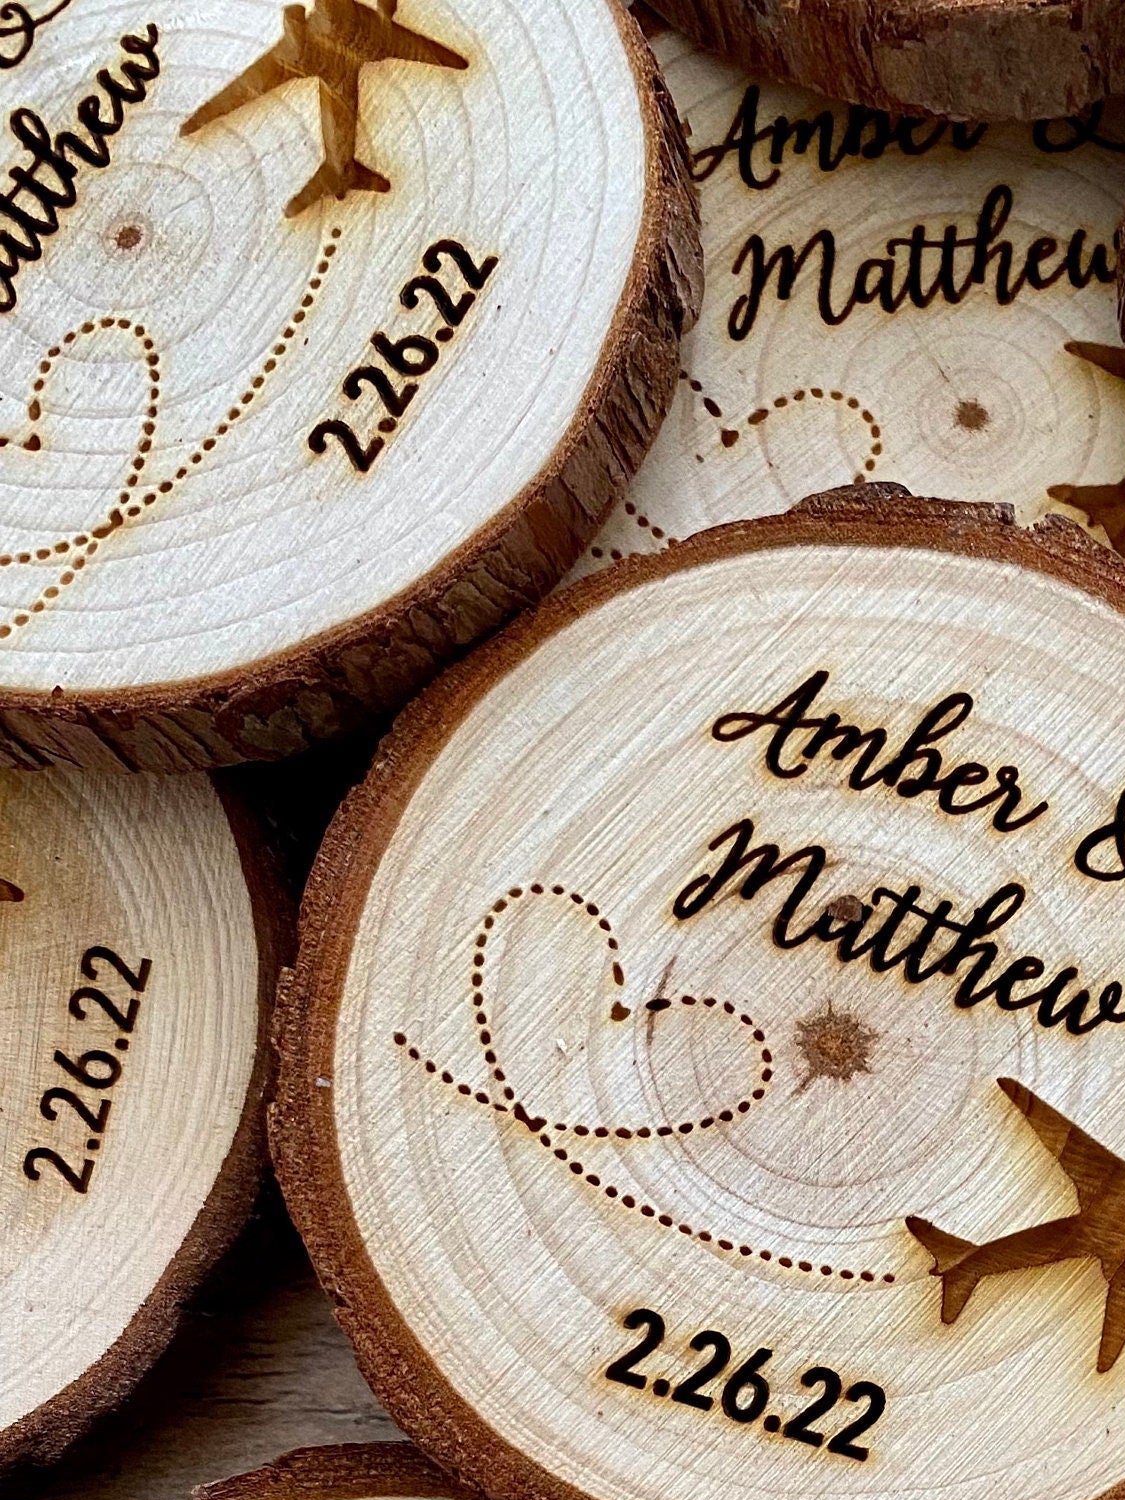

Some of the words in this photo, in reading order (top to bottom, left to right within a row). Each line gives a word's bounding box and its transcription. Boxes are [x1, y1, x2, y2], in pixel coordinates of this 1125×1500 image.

[0, 23, 160, 313] atthew
[309, 239, 498, 471] 2.26.22
[711, 670, 1050, 832] Amber
[23, 945, 152, 1193] 2.26.22
[606, 1308, 886, 1460] 2.26.22
